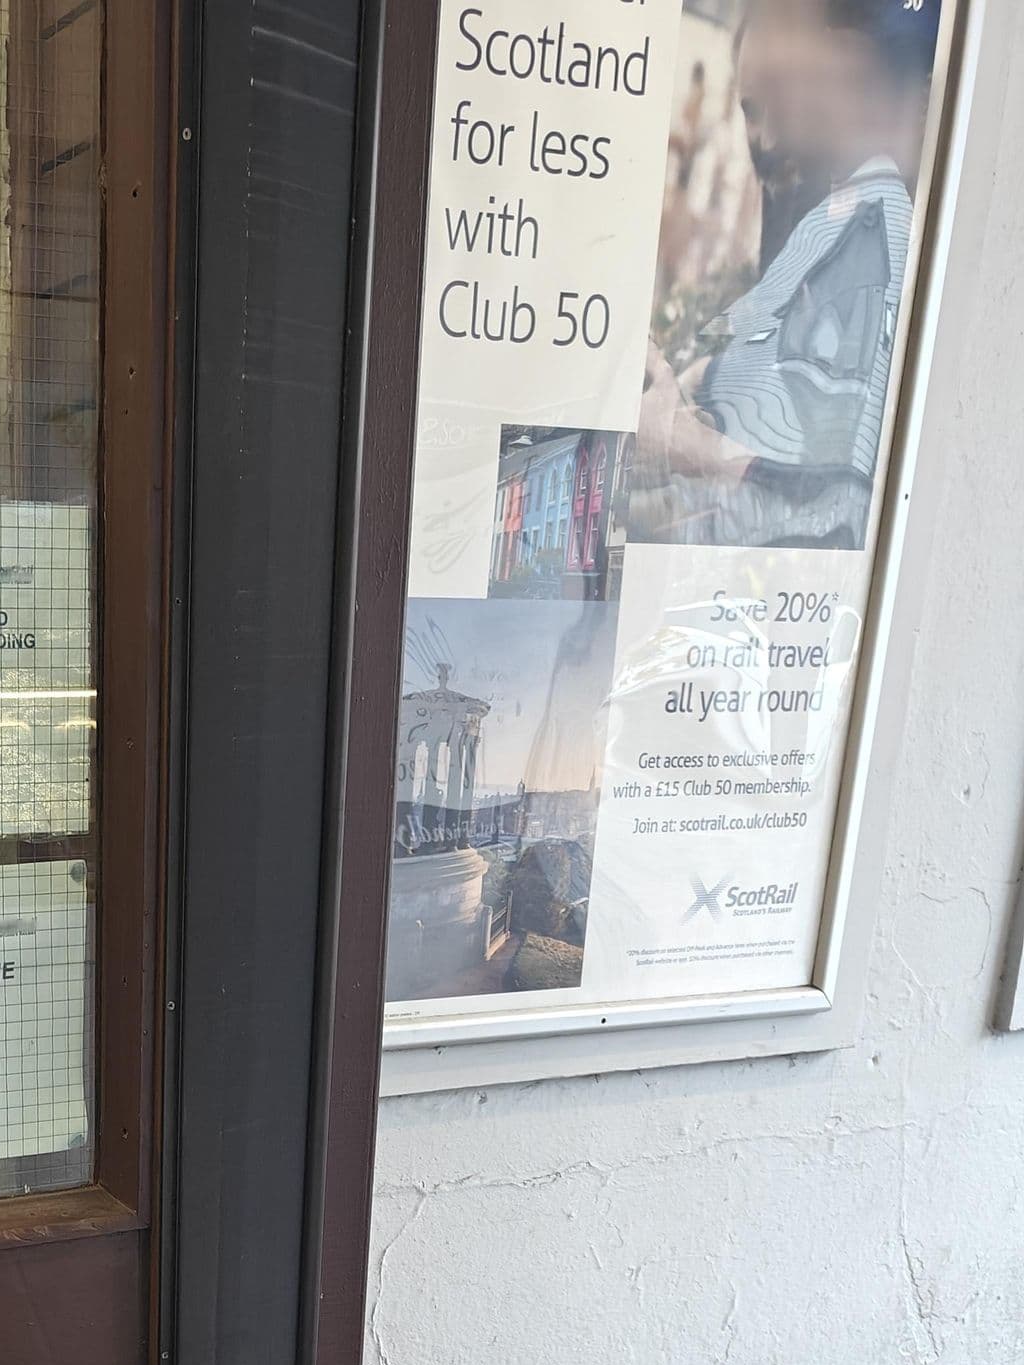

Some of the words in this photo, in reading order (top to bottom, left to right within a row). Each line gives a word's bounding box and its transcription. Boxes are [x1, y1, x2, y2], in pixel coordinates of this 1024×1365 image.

[455, 8, 650, 96] Scotland
[450, 100, 515, 166] for
[529, 110, 611, 179] less
[444, 195, 539, 259] with
[439, 280, 537, 342] Club
[552, 292, 610, 349] 50
[710, 591, 768, 621] Save
[687, 645, 715, 668] on
[768, 638, 829, 668] travel
[665, 682, 693, 713] all
[699, 690, 752, 722] year
[757, 690, 823, 712] round
[639, 752, 661, 768] Get
[664, 755, 703, 768] access
[707, 754, 719, 767] to
[723, 751, 778, 767] exclusive
[781, 750, 815, 765] offers
[614, 782, 641, 798] with
[644, 785, 651, 797] a
[656, 782, 680, 797] £15
[683, 781, 711, 796] Club
[715, 780, 731, 795] 50
[734, 777, 811, 797] membership.
[633, 818, 658, 834] Join
[661, 820, 677, 832] at:
[680, 813, 807, 831] scotrail.co.uk/club50
[725, 882, 798, 907] ScotRail
